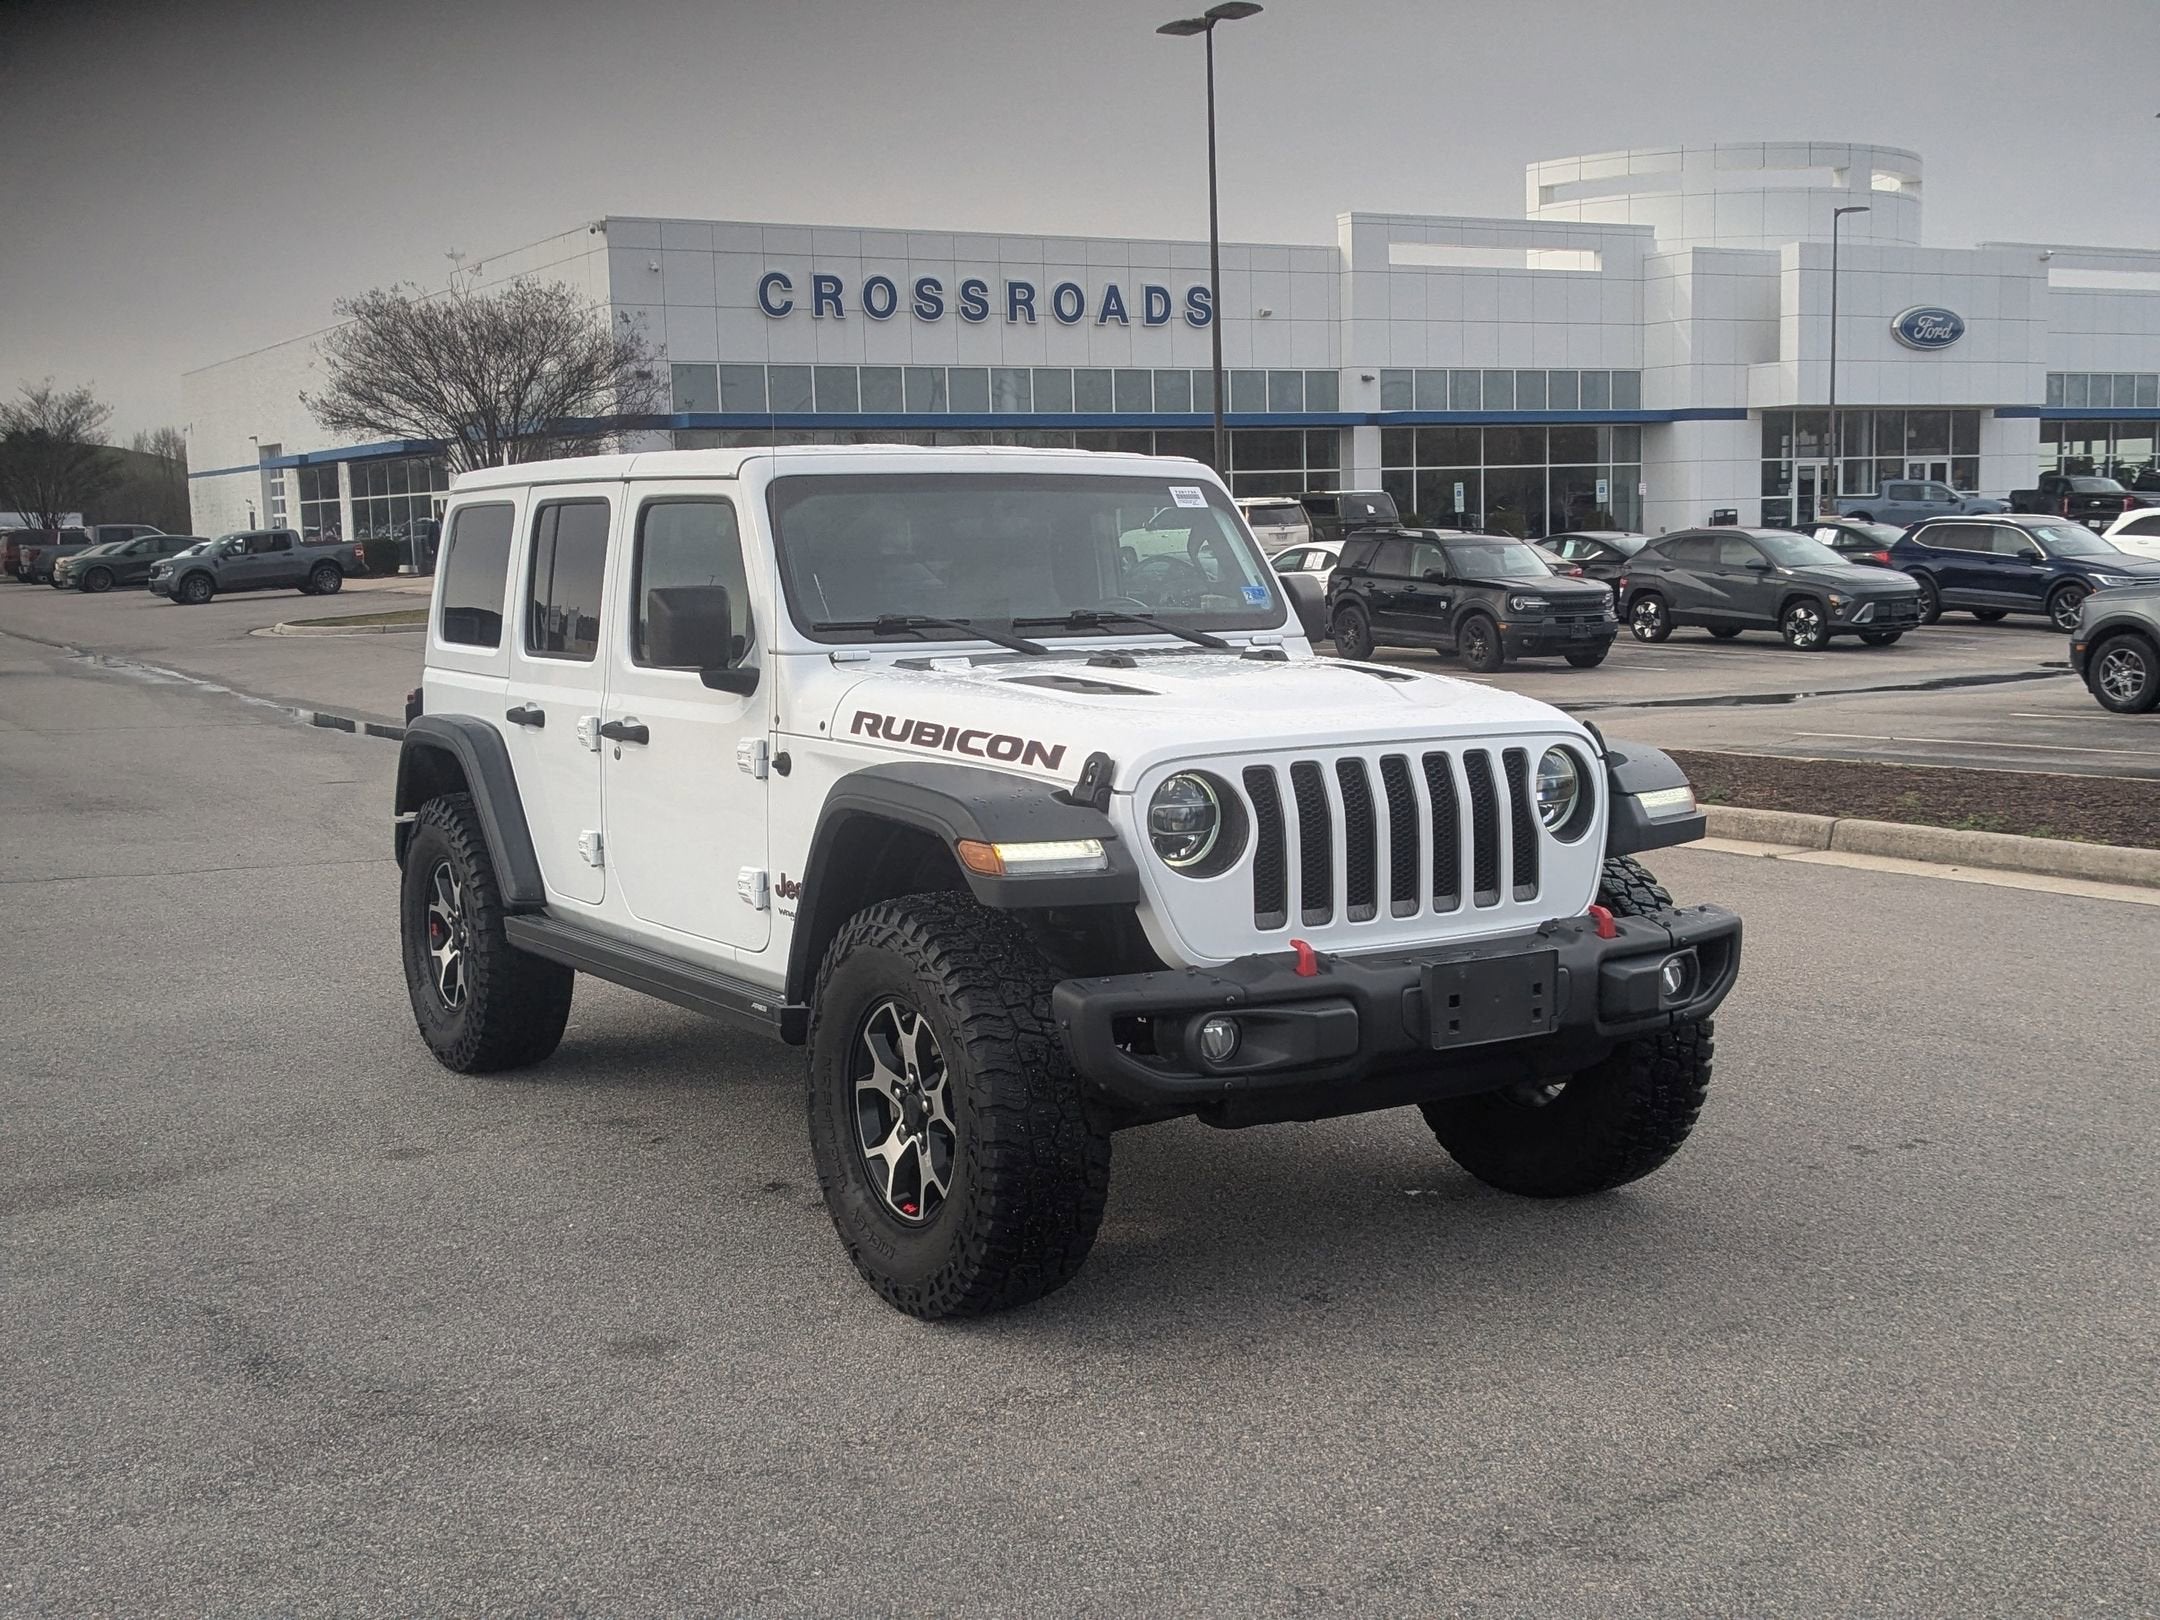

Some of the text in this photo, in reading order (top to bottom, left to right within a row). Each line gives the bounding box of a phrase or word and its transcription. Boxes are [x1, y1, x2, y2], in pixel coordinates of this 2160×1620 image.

[757, 271, 1213, 328] CROSSROADS
[1914, 316, 1954, 339] Ford
[850, 710, 1067, 770] RUBICON
